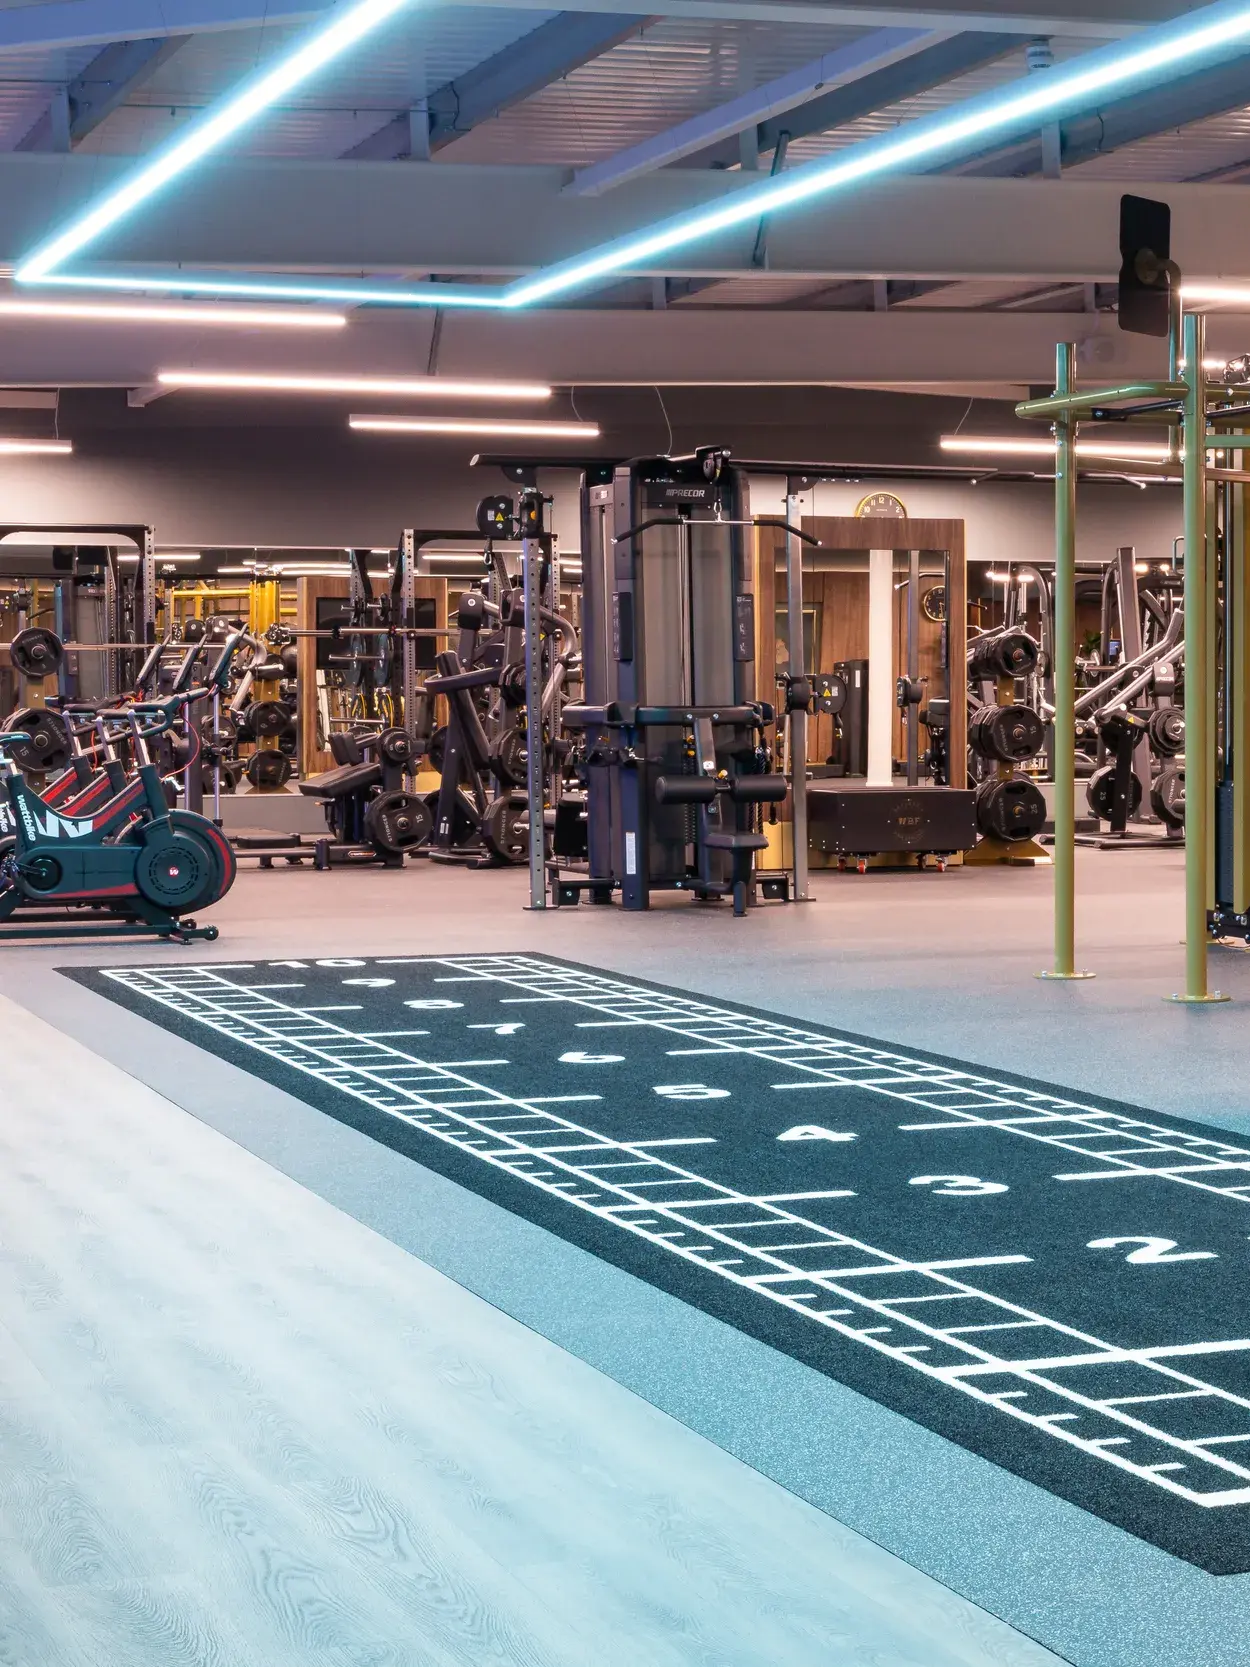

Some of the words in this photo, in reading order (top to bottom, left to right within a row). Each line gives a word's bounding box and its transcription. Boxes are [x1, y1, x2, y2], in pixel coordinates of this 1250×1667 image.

[673, 489, 705, 498] PRECOR
[878, 496, 885, 504] 12
[19, 746, 30, 757] 15
[1031, 803, 1038, 814] 25
[17, 794, 36, 841] wattbike
[415, 814, 425, 823] 15
[267, 959, 367, 969] 10
[341, 977, 397, 988] 9
[403, 999, 465, 1010] 8
[466, 1022, 526, 1035] 7
[557, 1051, 626, 1064] 6
[652, 1083, 732, 1100] 5
[775, 1124, 860, 1142] 4
[907, 1174, 1010, 1196] 3
[1085, 1235, 1220, 1265] 2
